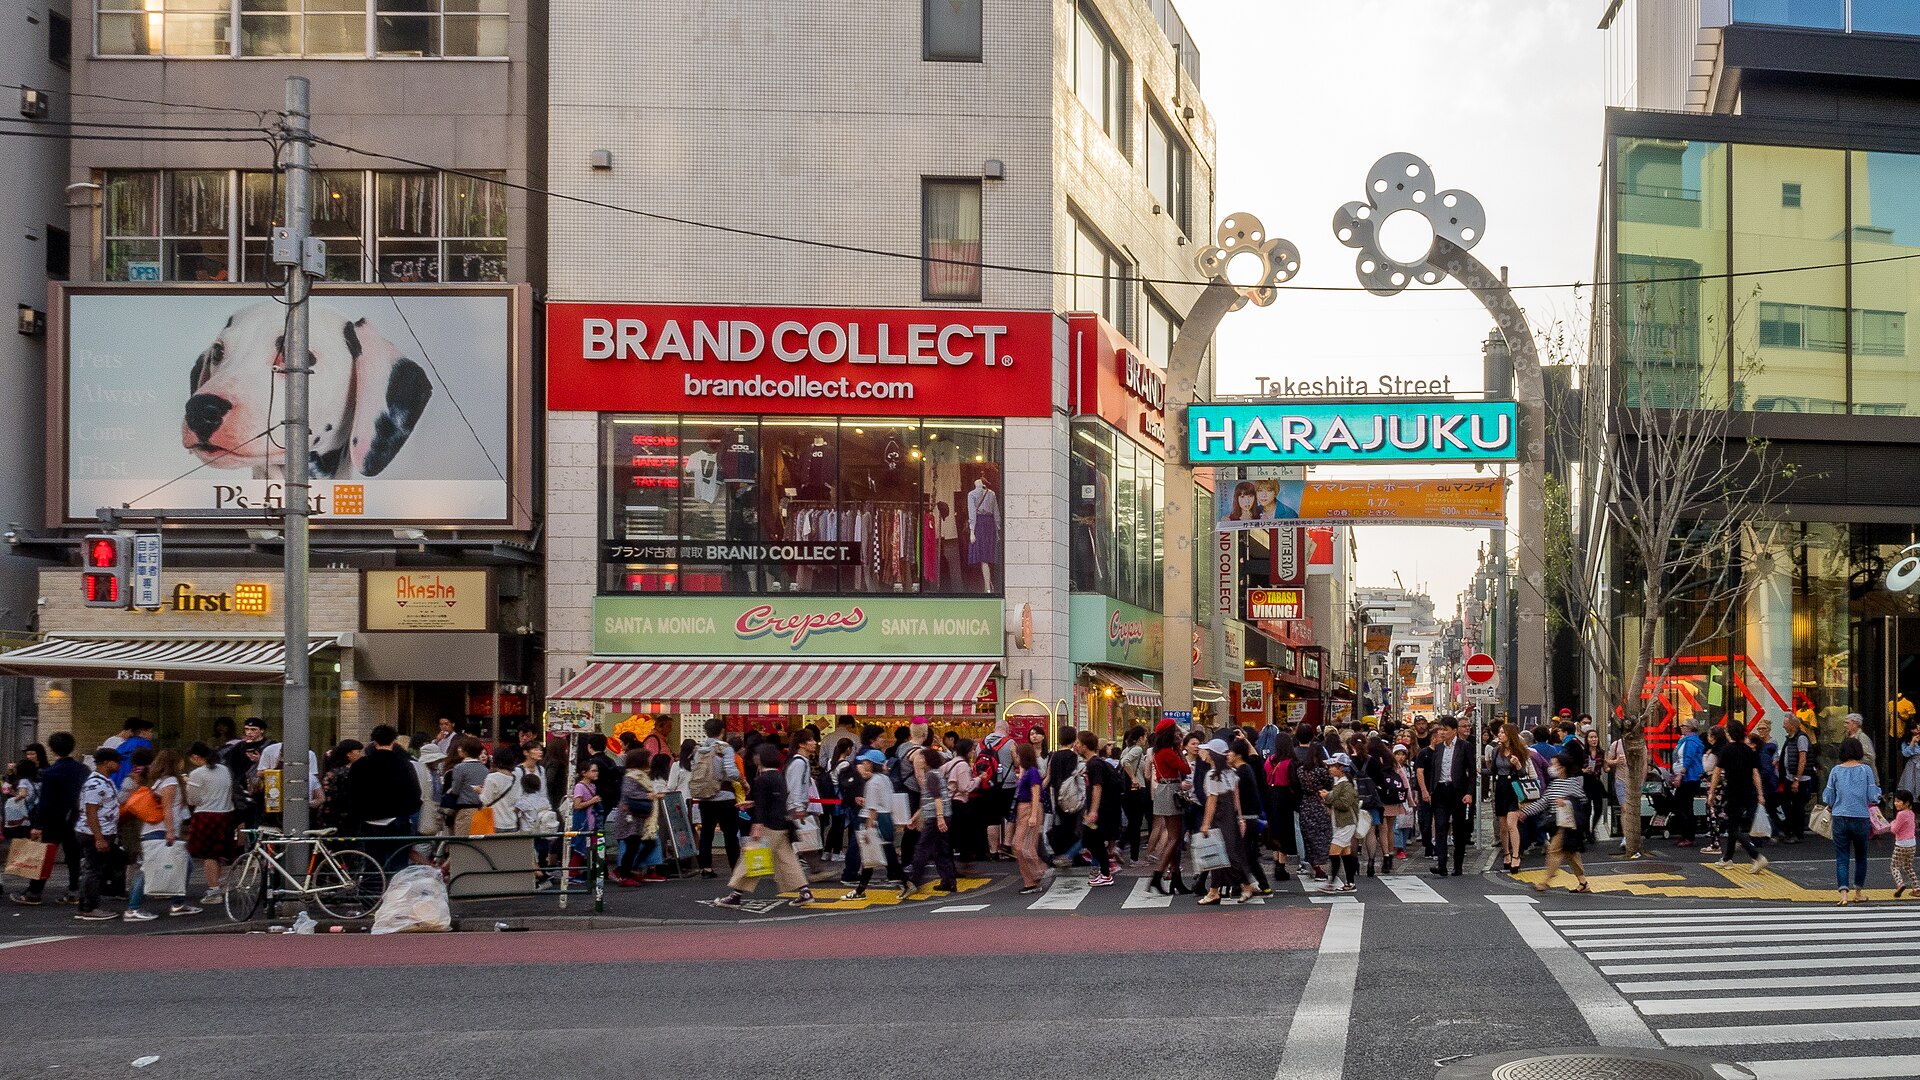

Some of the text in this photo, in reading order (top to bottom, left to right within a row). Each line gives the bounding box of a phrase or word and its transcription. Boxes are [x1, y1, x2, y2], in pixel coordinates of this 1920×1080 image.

[129, 267, 160, 281] OPEN
[582, 318, 765, 363] BRAND
[78, 351, 122, 369] Pets
[684, 373, 914, 400] brandcollect.com
[1125, 350, 1164, 411] BRAND
[1256, 375, 1452, 397] Takeshita Street
[76, 421, 137, 441] Come
[1196, 413, 1510, 453] HARAJUKU
[632, 435, 679, 447] SECOND
[78, 456, 129, 475] First
[632, 457, 664, 467] HAND
[635, 478, 656, 487] TAX
[212, 484, 327, 514] P's-fit
[706, 545, 767, 560] BRAND
[397, 575, 456, 598] Akasha
[1267, 592, 1297, 604] TABASA
[1252, 605, 1298, 618] VIKING!
[605, 617, 717, 634] SANTA MONICA
[735, 604, 869, 651] Crepes
[881, 618, 990, 636] SANTA MONICA
[117, 669, 153, 680] P's-first
